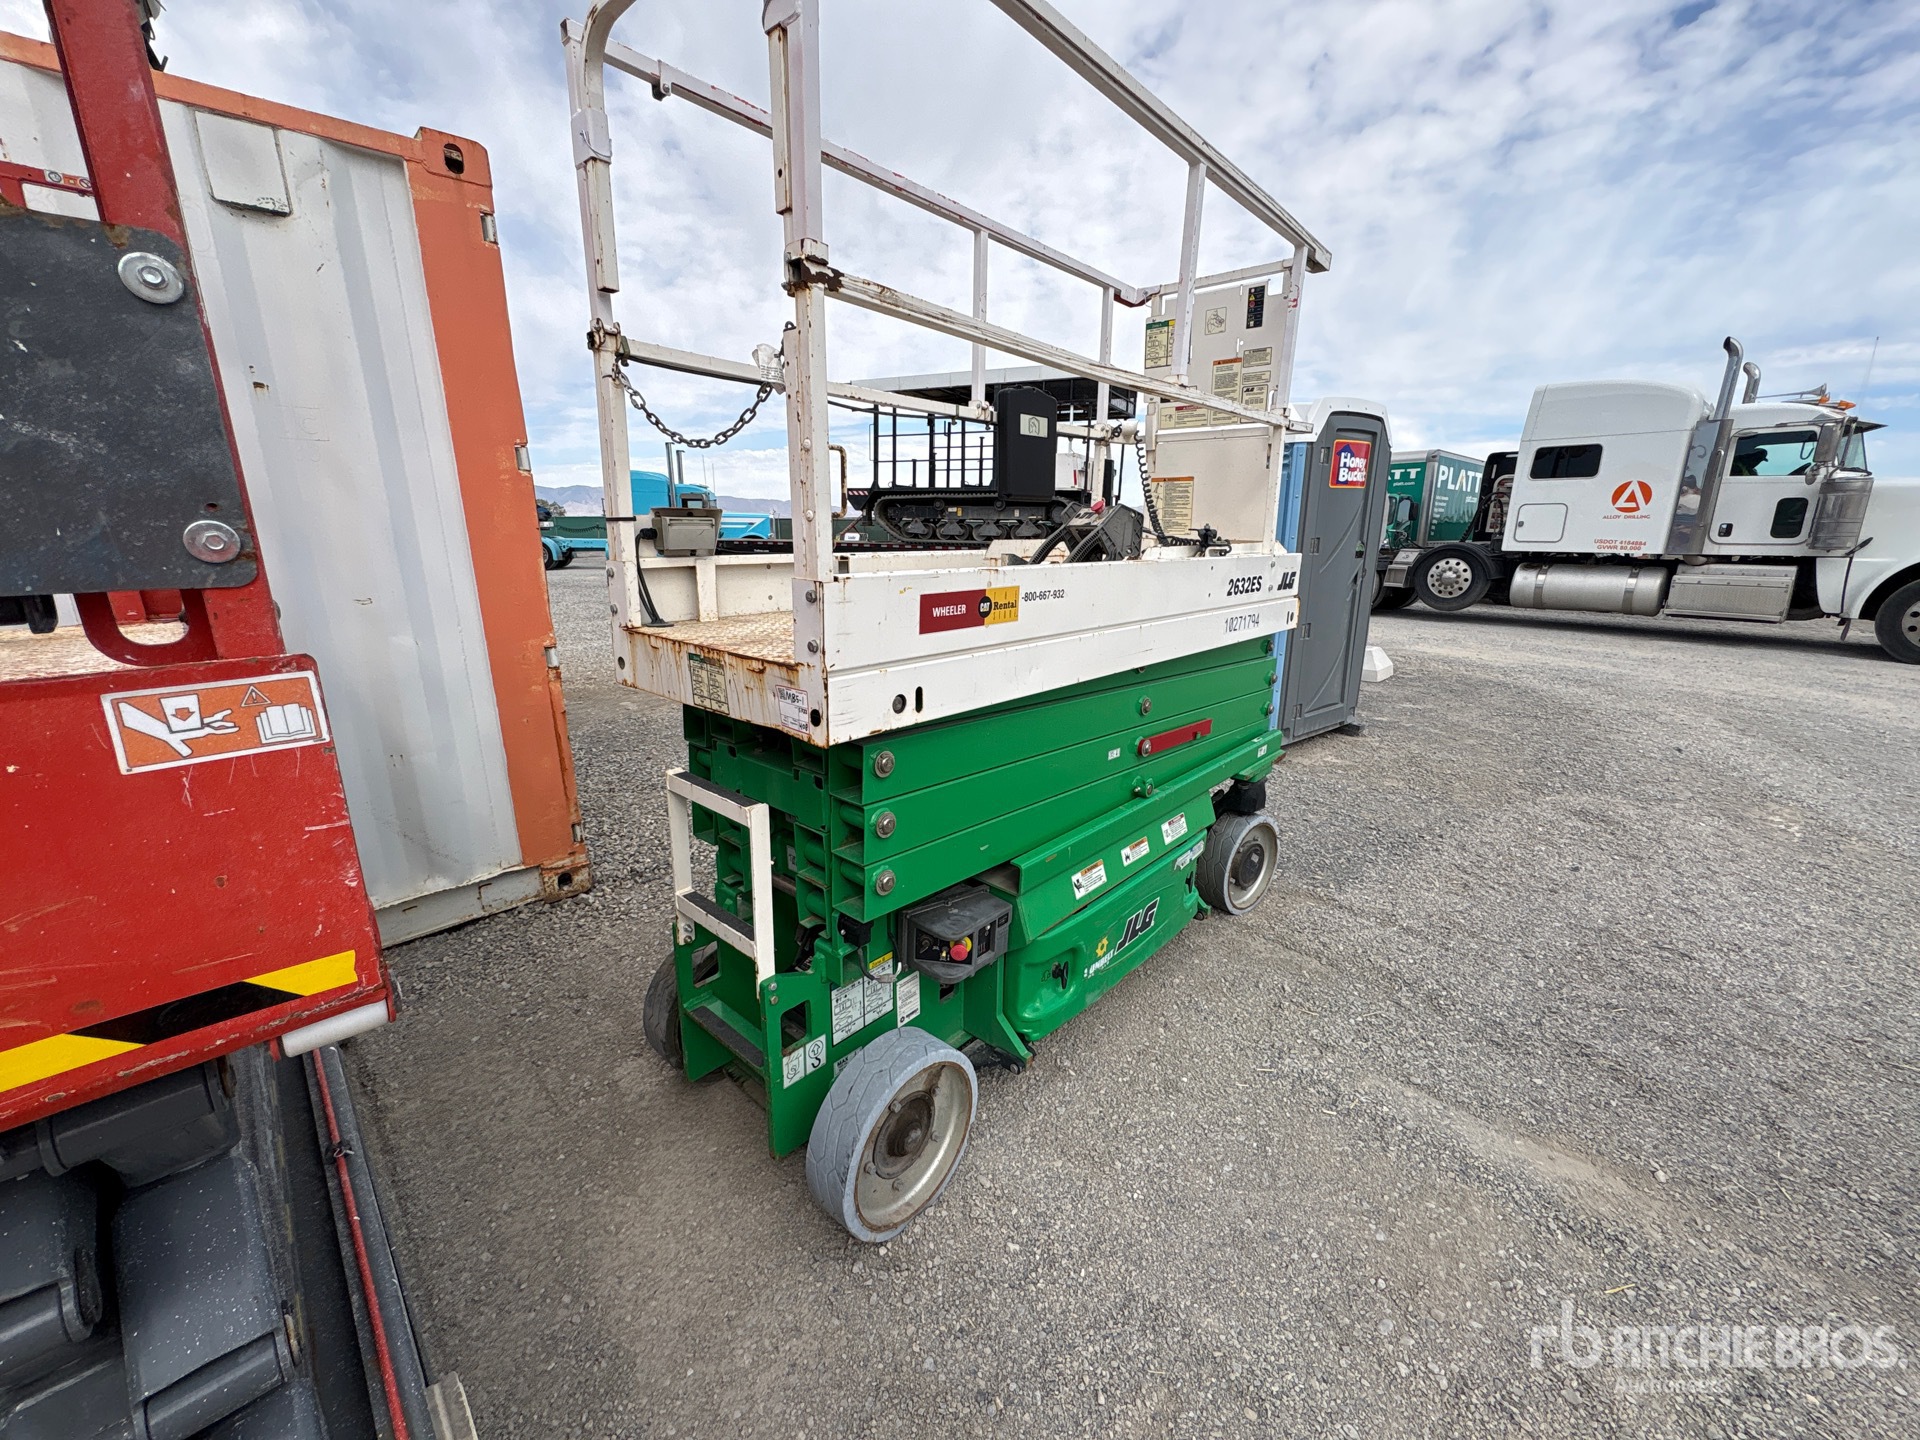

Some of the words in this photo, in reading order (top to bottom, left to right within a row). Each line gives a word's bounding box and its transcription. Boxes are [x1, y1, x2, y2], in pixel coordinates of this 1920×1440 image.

[1437, 465, 1482, 493] PLATT
[1226, 575, 1263, 597] 2632ES
[1277, 571, 1297, 591] JLG
[932, 604, 967, 618] WHEELER
[979, 602, 990, 612] CAT
[993, 600, 1017, 611] Rental
[1114, 897, 1160, 955] JLG
